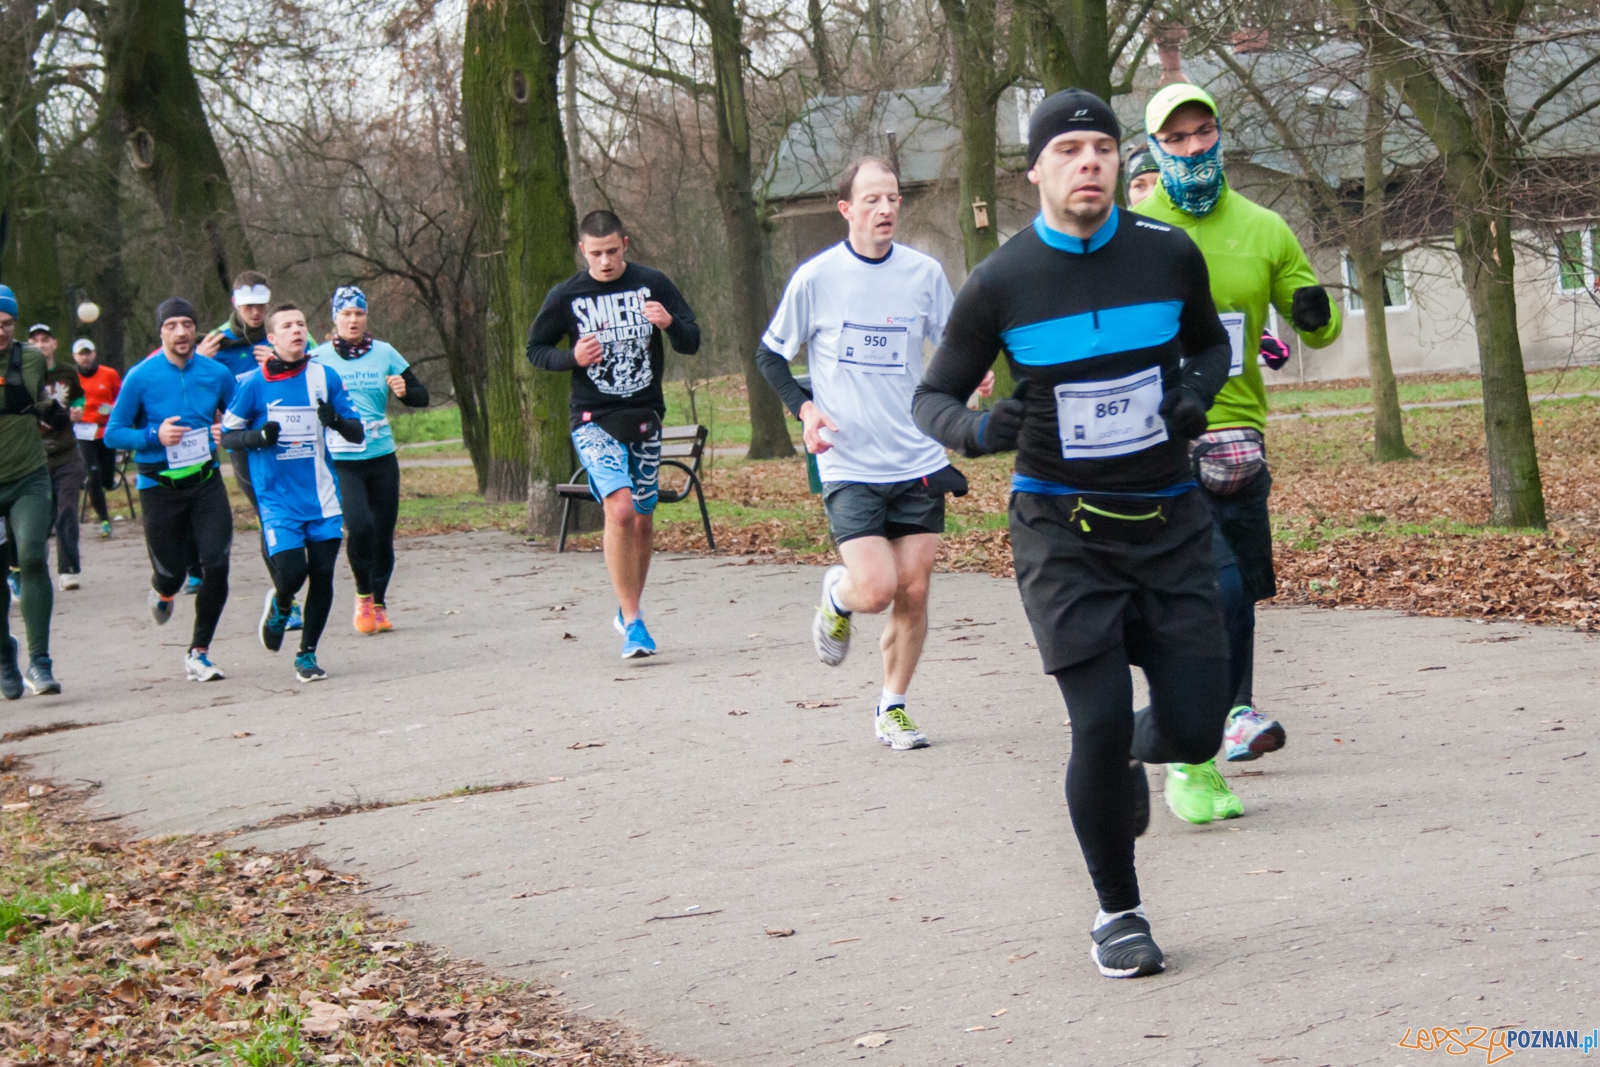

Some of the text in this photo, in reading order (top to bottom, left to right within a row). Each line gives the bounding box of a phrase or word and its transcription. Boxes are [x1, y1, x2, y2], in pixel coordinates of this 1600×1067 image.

[864, 335, 887, 347] 950
[1096, 398, 1131, 419] 867
[181, 439, 198, 448] 920
